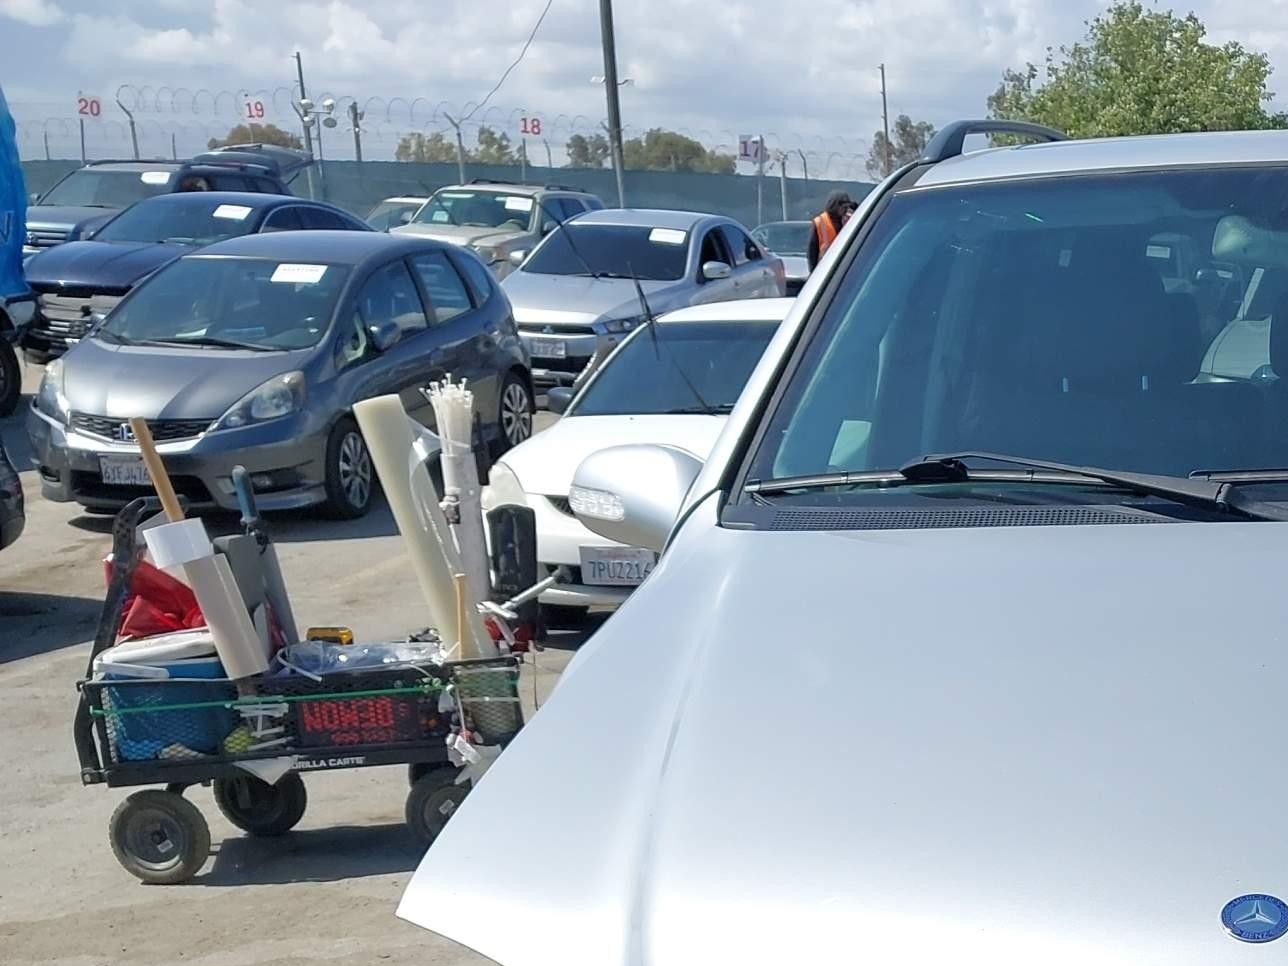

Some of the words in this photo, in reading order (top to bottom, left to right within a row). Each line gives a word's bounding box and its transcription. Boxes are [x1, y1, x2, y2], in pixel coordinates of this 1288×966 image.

[78, 98, 101, 117] 20
[245, 101, 265, 118] 19
[520, 117, 541, 135] 18
[740, 140, 759, 158] 17
